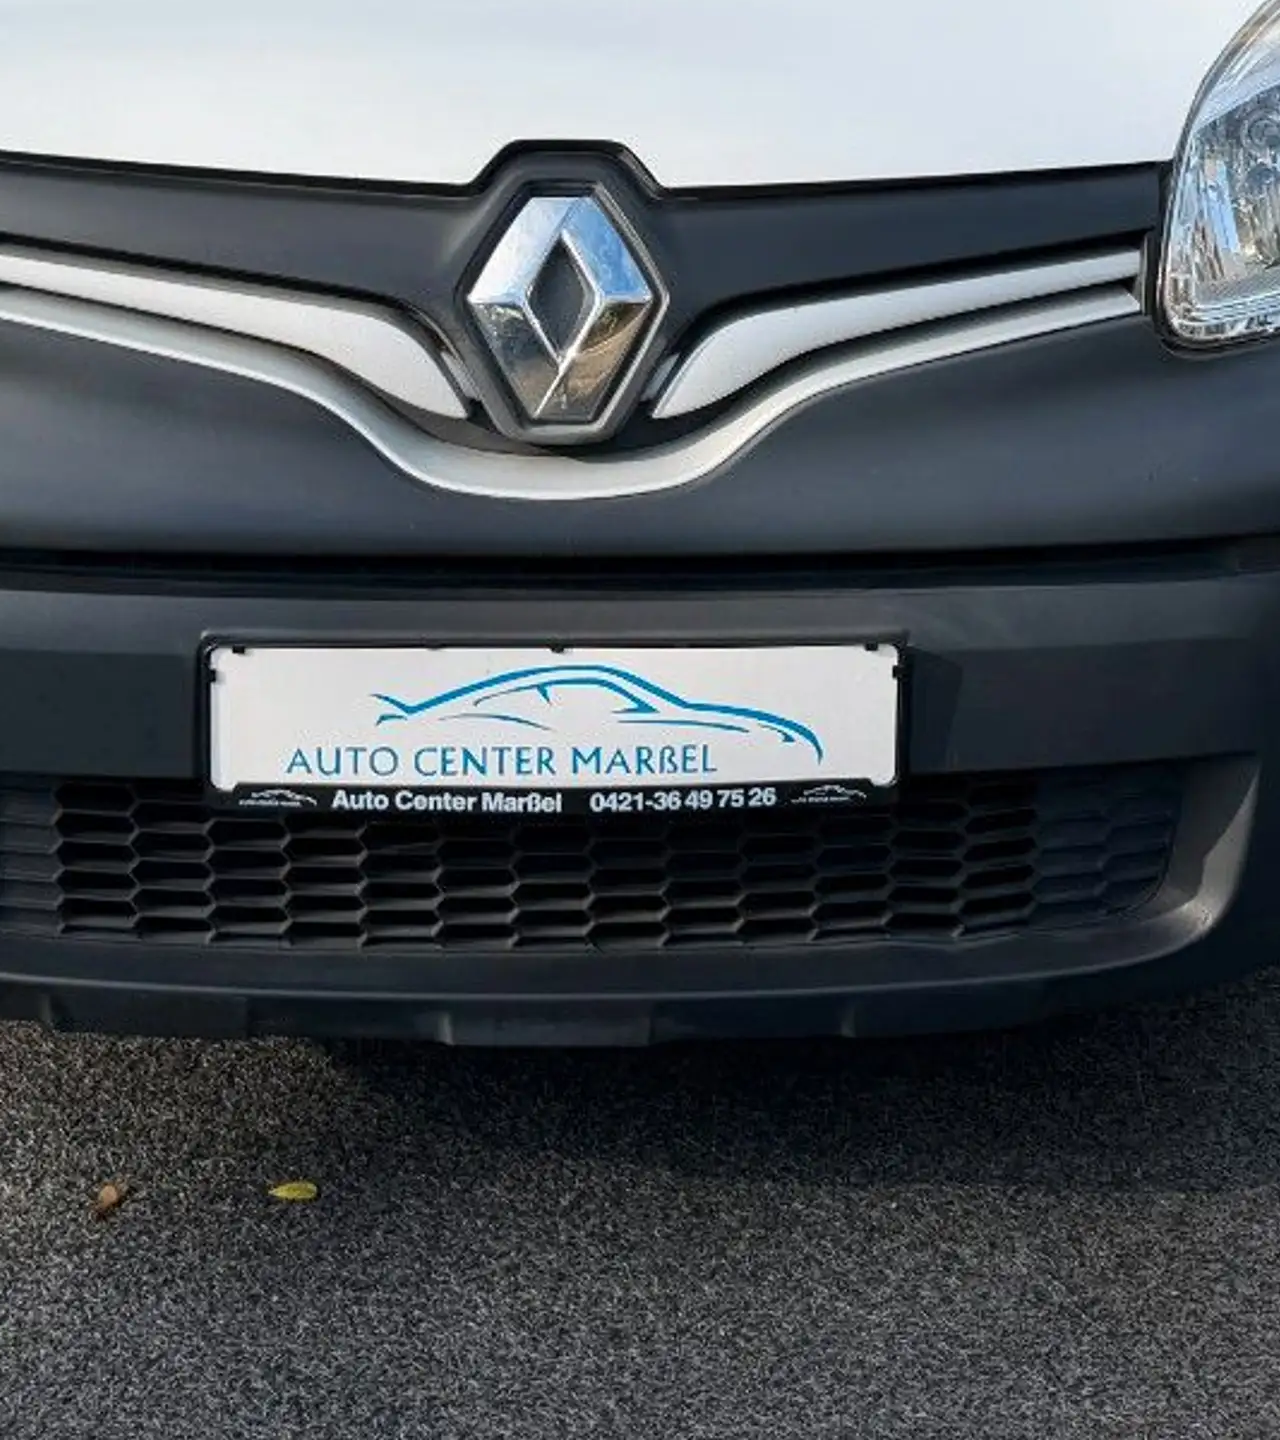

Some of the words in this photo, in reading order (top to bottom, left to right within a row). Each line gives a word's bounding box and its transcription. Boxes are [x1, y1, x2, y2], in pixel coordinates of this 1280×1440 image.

[285, 745, 400, 778] AUTO
[413, 745, 558, 778] CENTER
[331, 789, 390, 811] Auto
[395, 790, 478, 813] Center
[589, 791, 682, 813] 0421-36
[684, 790, 714, 811] 49
[717, 789, 745, 809] 75
[747, 787, 778, 808] 26
